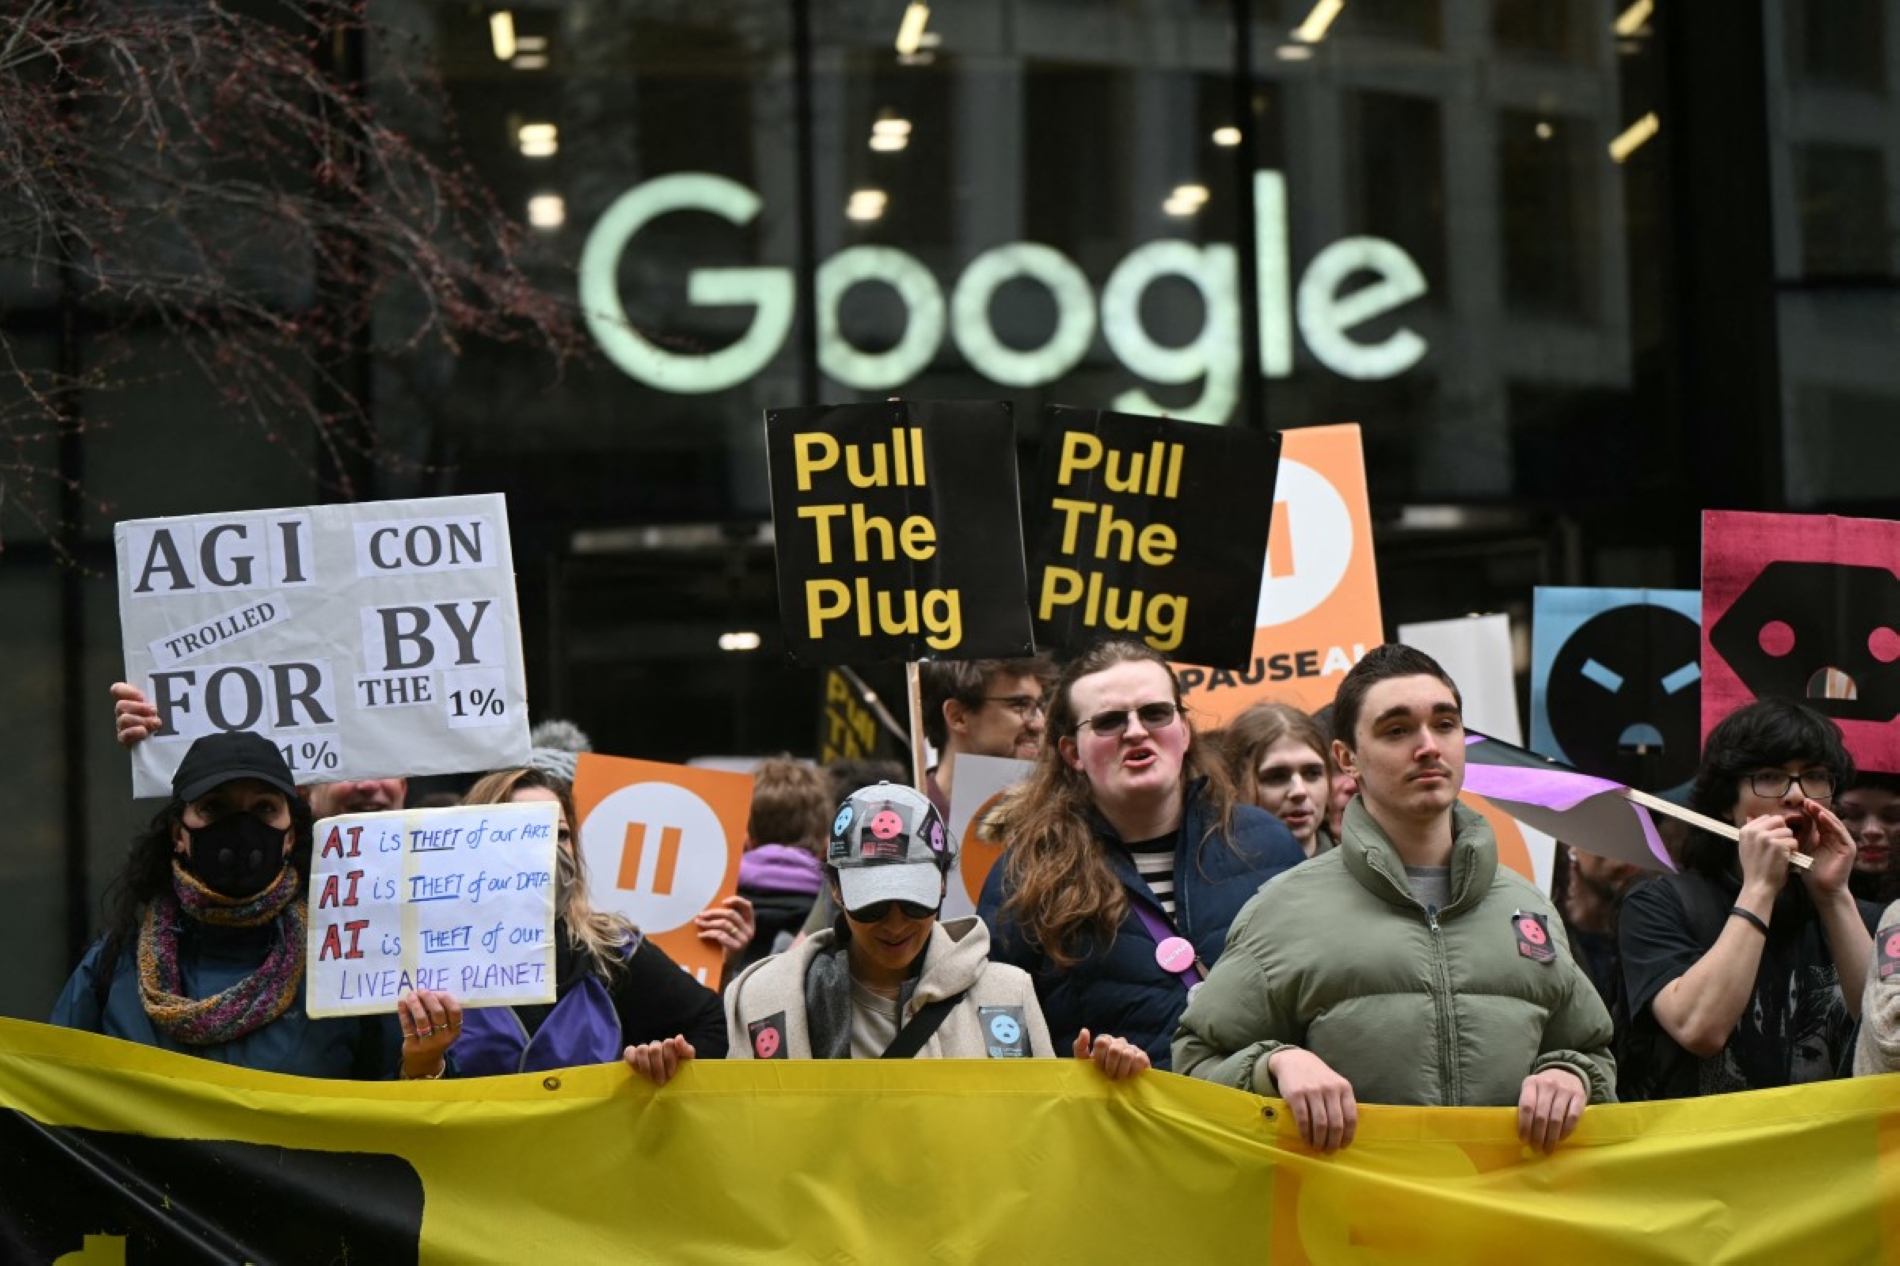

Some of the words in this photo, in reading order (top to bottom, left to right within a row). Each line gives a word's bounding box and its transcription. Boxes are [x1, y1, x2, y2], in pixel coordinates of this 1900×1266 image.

[580, 171, 1426, 425] Google
[793, 427, 926, 491] Pull
[1057, 431, 1184, 498] Pull
[133, 520, 307, 593] AGI
[369, 522, 482, 570] CON
[797, 503, 937, 564] The
[1052, 498, 1177, 566] The
[164, 601, 276, 659] TROLLED
[376, 600, 491, 672] BY
[805, 577, 963, 650] Plug
[1039, 565, 1189, 651] Plug
[149, 662, 334, 737] FOR
[357, 675, 432, 706] THE
[449, 688, 505, 717] 1%
[280, 741, 338, 770] 1%
[321, 825, 364, 859] AI
[379, 831, 402, 853] is
[409, 828, 464, 852] THEFT
[466, 819, 489, 849] of
[490, 829, 518, 845] our
[319, 870, 365, 909] AI
[373, 876, 396, 900] is
[408, 873, 465, 901] THEFT
[468, 871, 487, 903] of
[487, 876, 511, 891] our
[516, 871, 551, 890] DATA
[319, 919, 370, 961] AI
[381, 933, 402, 956] is
[420, 925, 473, 953] THEFT
[481, 921, 505, 953] of
[509, 926, 545, 945] our
